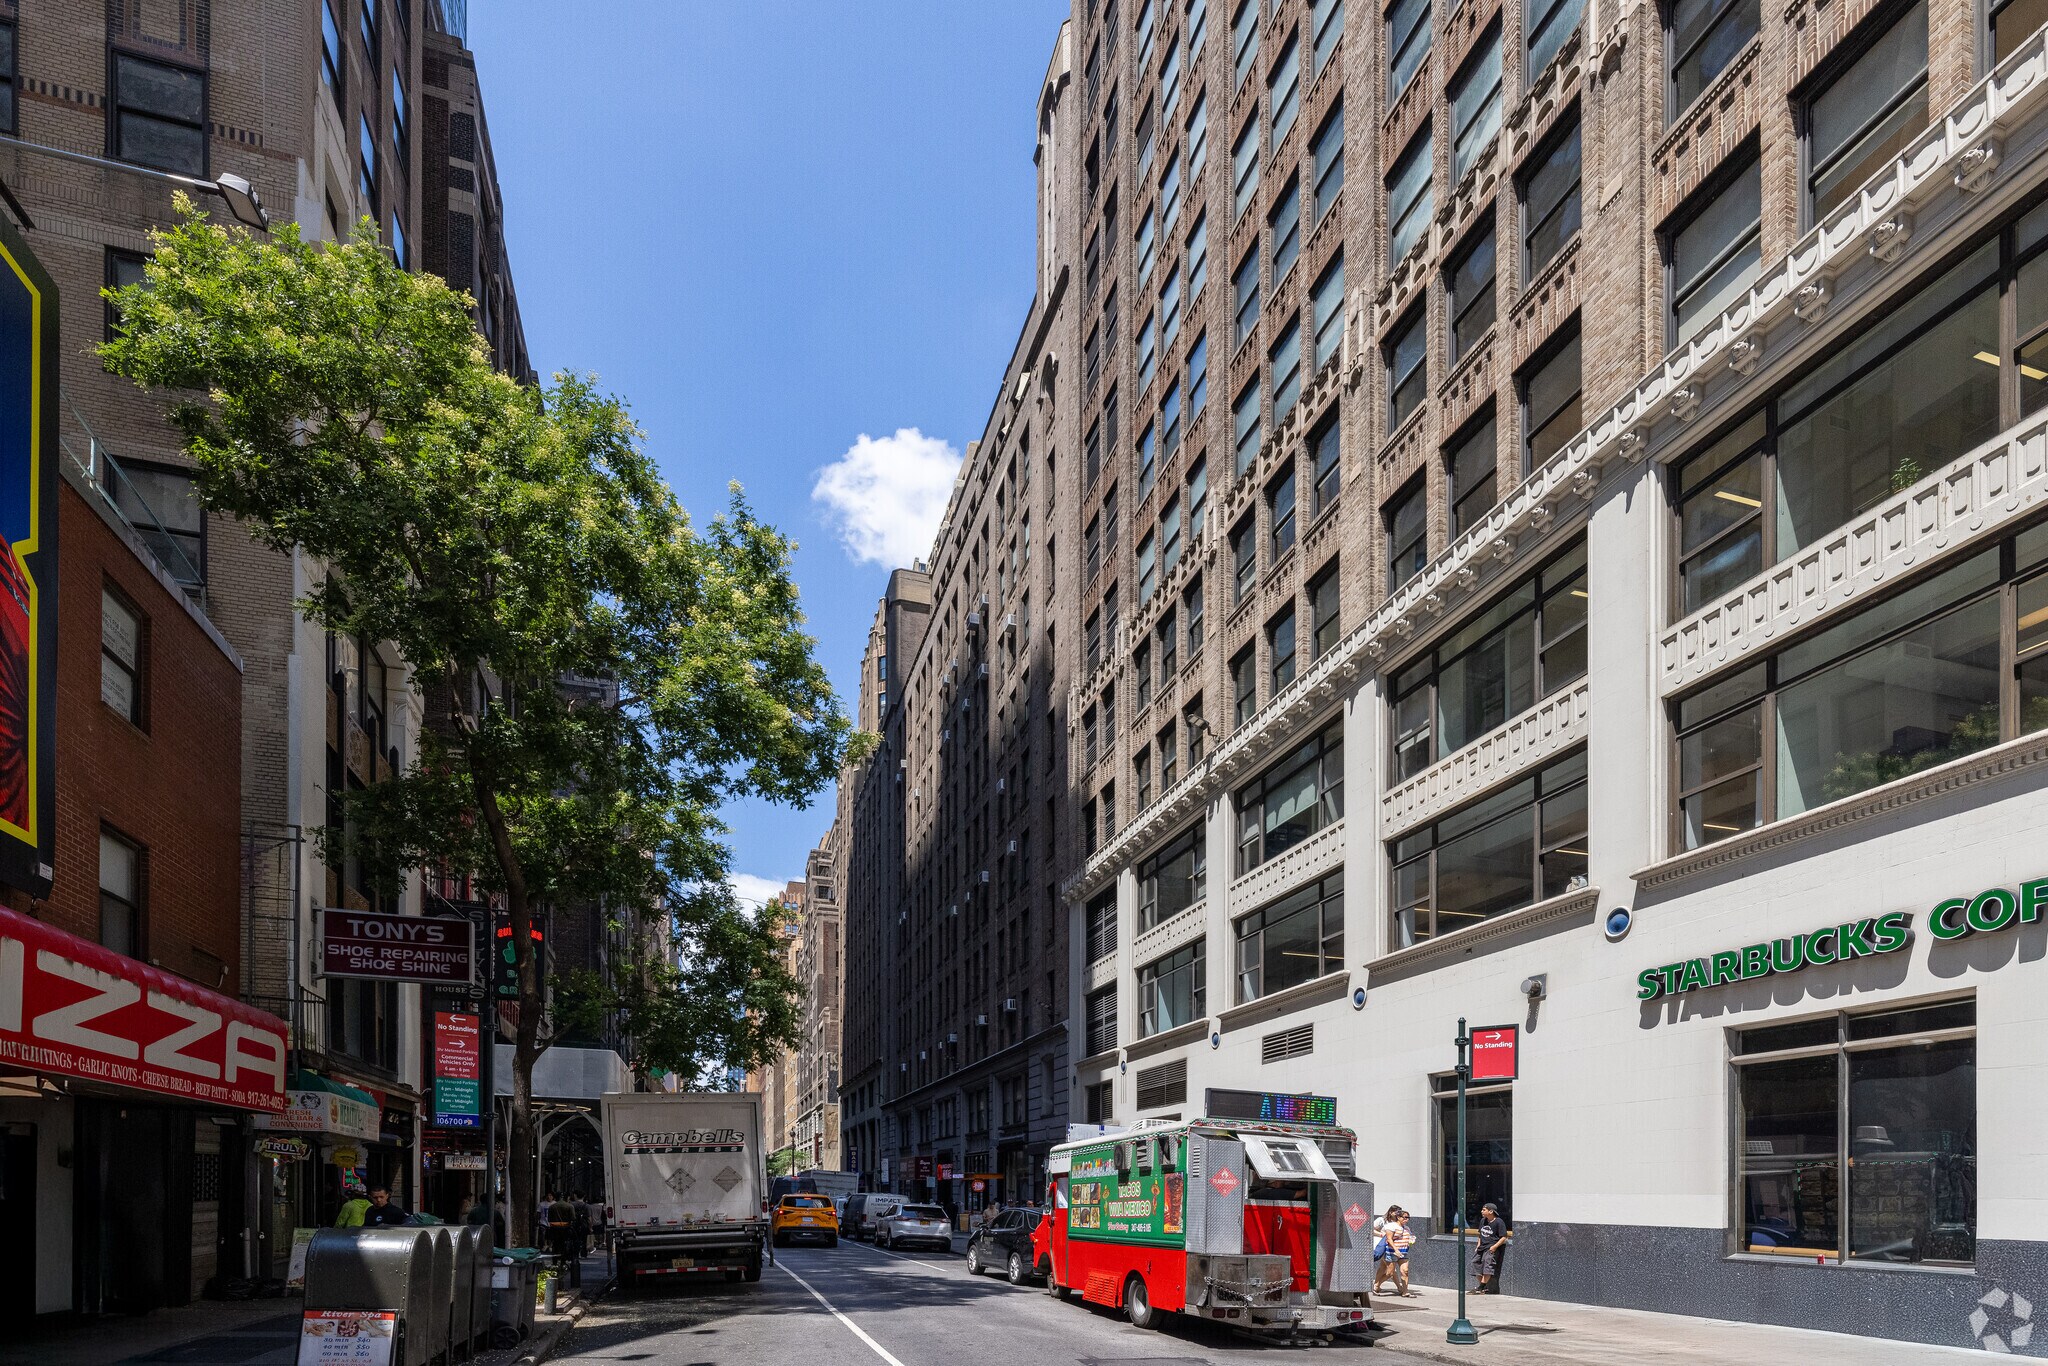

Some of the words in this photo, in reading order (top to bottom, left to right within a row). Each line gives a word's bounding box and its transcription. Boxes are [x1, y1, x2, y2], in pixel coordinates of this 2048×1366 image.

[347, 919, 445, 943] TONY'S
[327, 944, 374, 957] SHOE
[380, 948, 468, 964] REPAIRING
[1636, 911, 1911, 1000] STARBUCKS
[350, 957, 396, 970] SHOE
[401, 961, 451, 974] SHINE
[448, 1025, 478, 1034] Standing
[1484, 1041, 1513, 1049] Standing
[79, 1056, 110, 1076] GARLIC
[111, 1063, 137, 1082] KNOTS
[142, 1070, 170, 1089] CHEESE
[170, 1077, 192, 1093] BREAD
[195, 1082, 211, 1097] BEEF
[211, 1085, 229, 1100] PATTY
[231, 1089, 246, 1103] SODA
[1260, 1096, 1271, 1119] A
[1276, 1097, 1335, 1122] MEXICO
[437, 1117, 463, 1125] 106700
[622, 1129, 745, 1147] Campbell's
[266, 1141, 301, 1153] TRULY
[1119, 1181, 1141, 1198] TACOS
[1109, 1200, 1123, 1217] VIVA
[1124, 1199, 1152, 1217] MEXICO
[360, 1311, 382, 1319] Spa
